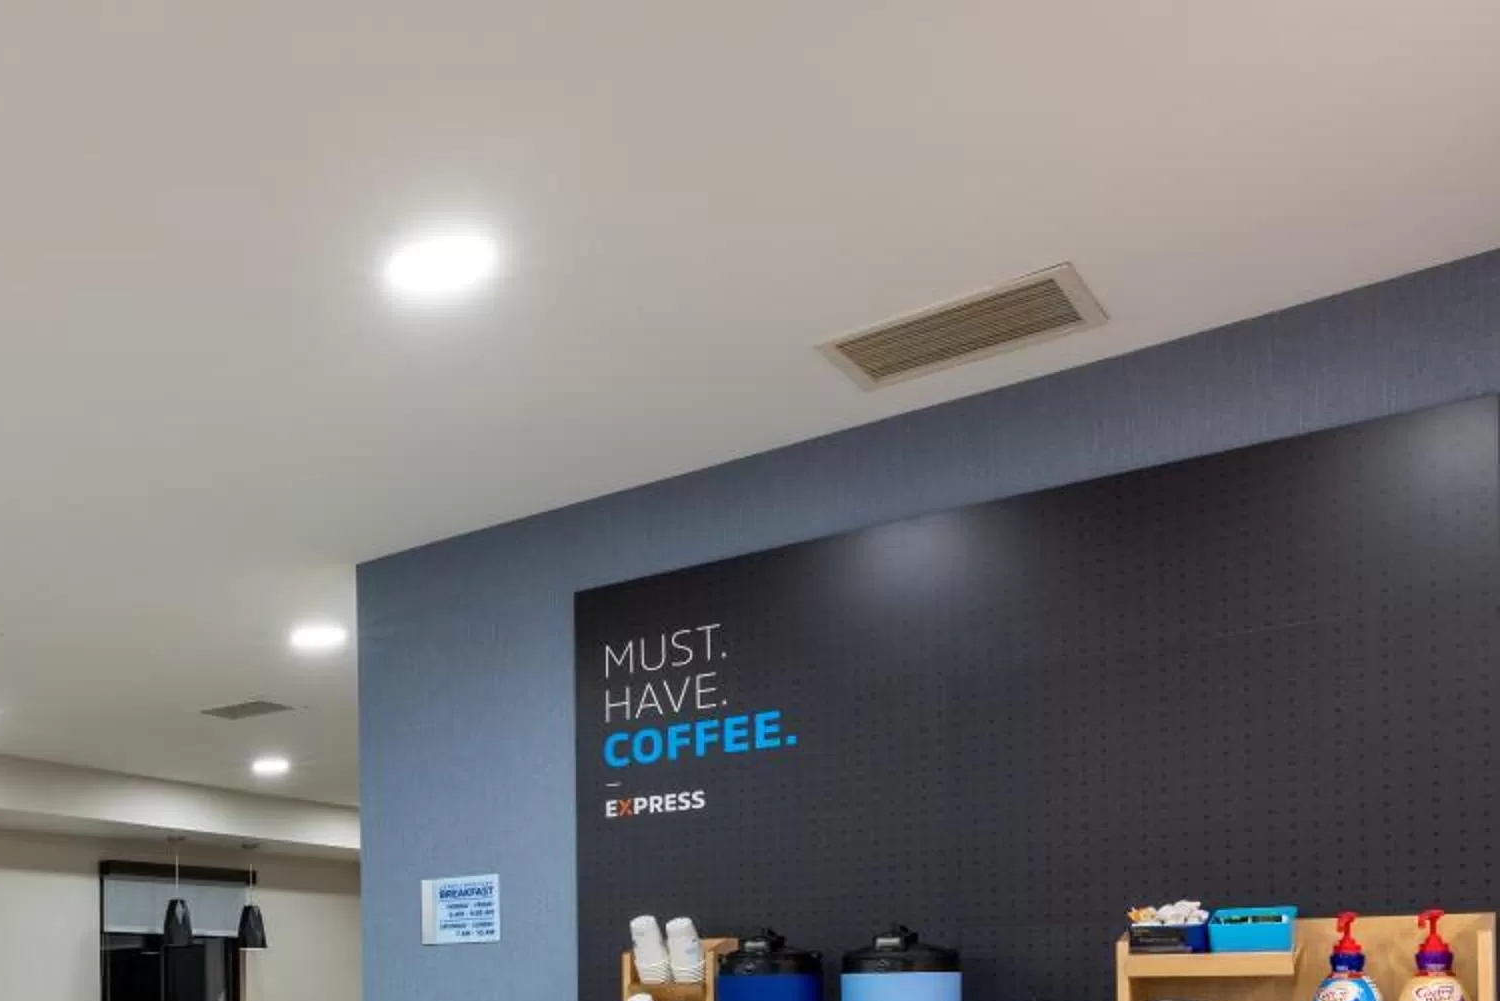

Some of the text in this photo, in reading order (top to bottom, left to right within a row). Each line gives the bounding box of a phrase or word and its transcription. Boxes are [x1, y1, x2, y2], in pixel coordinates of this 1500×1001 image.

[605, 624, 728, 679] MUST.
[605, 672, 728, 723] HAVE.
[604, 711, 798, 768] COFFEE.
[605, 790, 706, 818] EXPRESS
[439, 886, 494, 899] BREAKFAST
